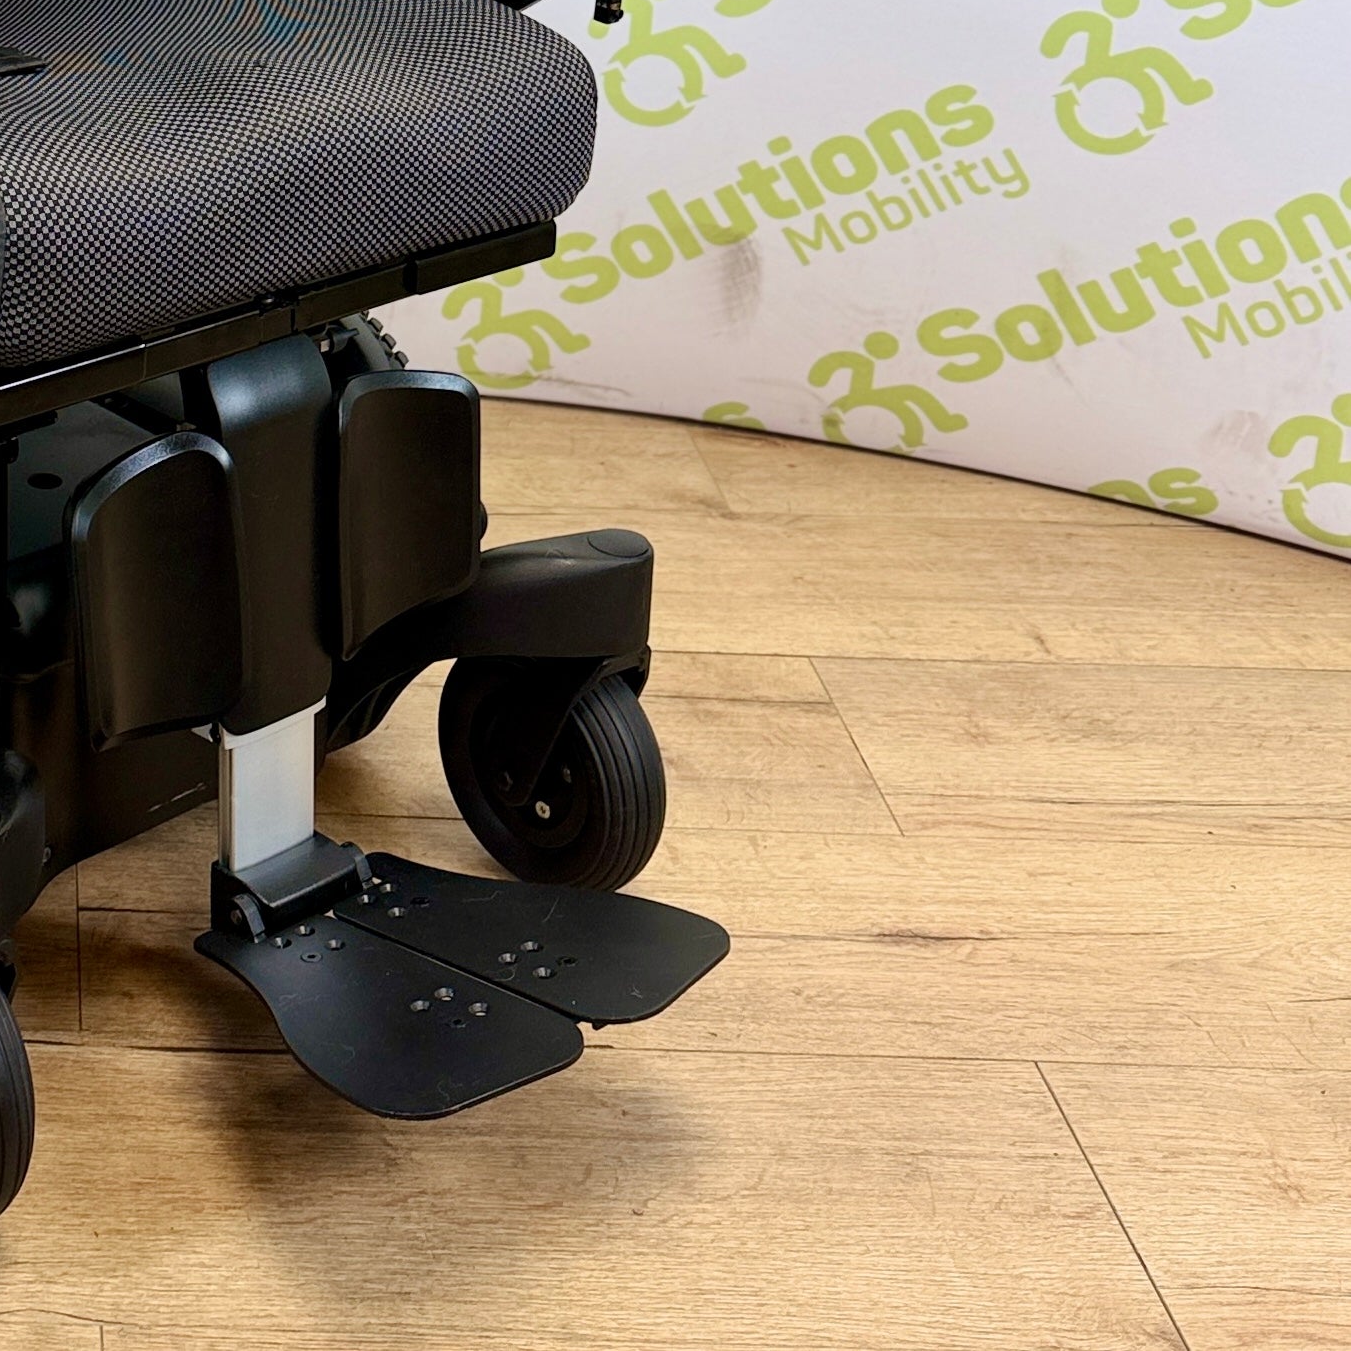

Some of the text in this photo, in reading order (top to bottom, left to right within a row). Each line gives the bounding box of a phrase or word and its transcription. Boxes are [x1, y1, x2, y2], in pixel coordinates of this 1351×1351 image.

[540, 84, 996, 305] Solutions
[781, 147, 1031, 266] Mobility
[916, 177, 1351, 383] Solution
